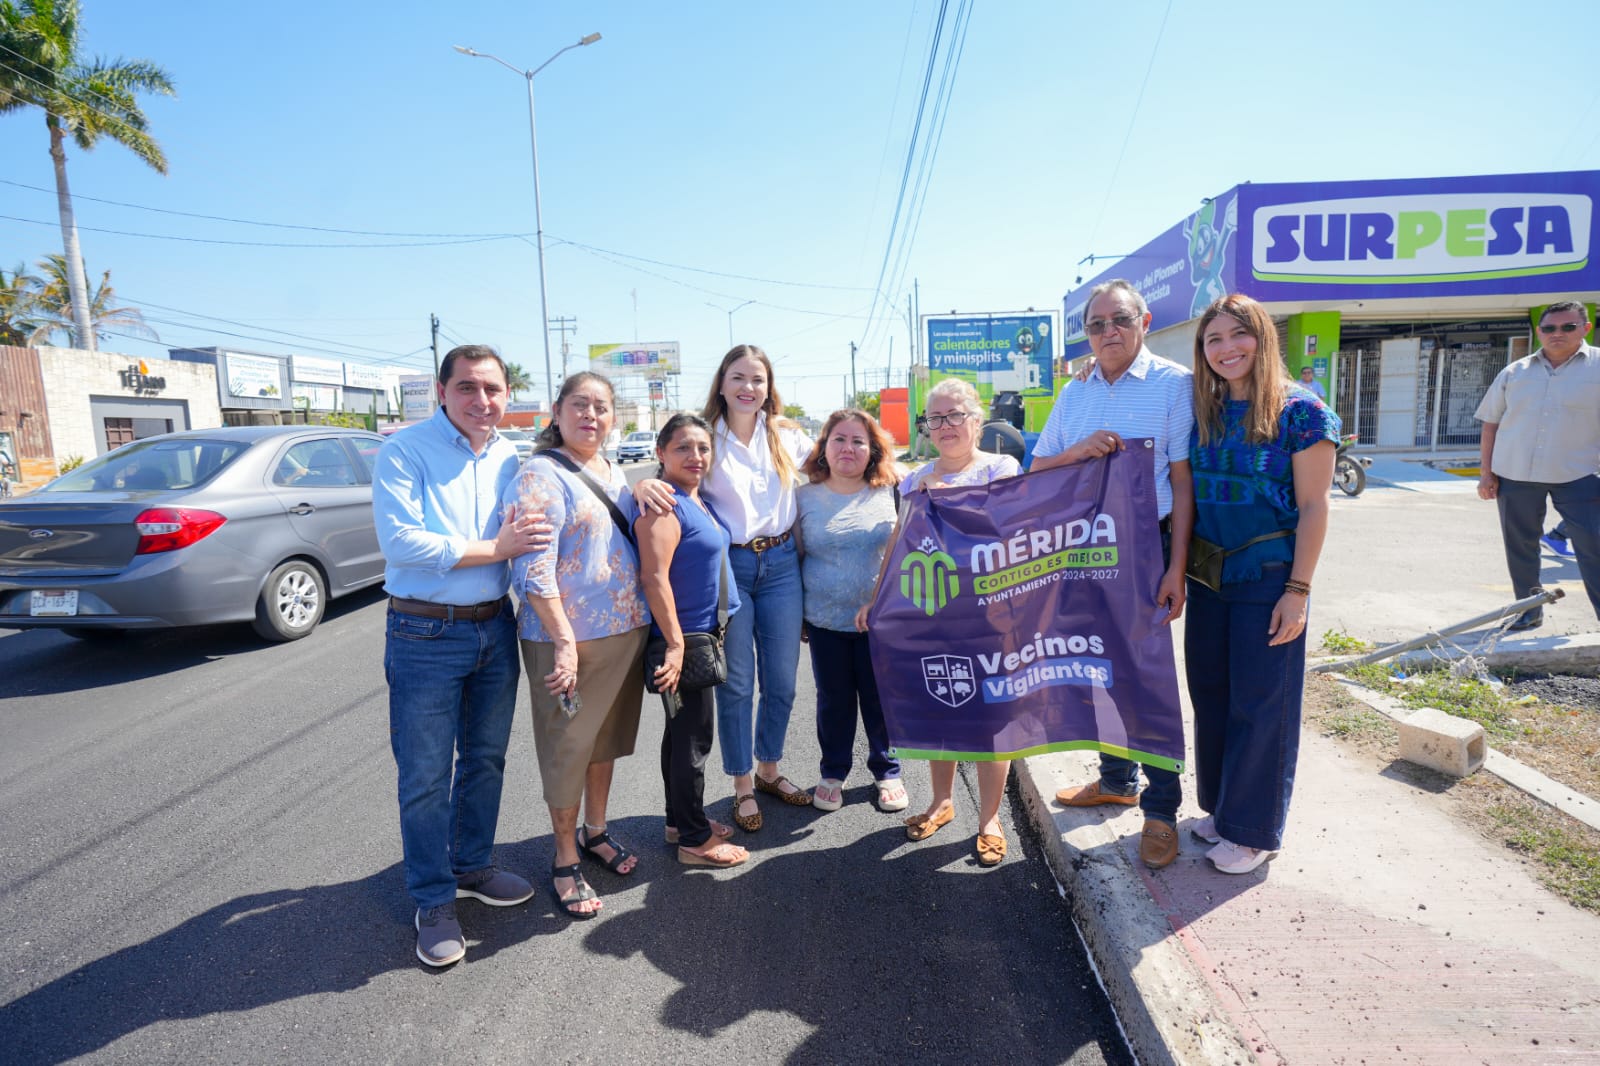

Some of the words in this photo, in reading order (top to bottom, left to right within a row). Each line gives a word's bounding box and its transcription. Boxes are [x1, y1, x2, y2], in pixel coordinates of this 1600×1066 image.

[1266, 205, 1574, 263] SURPESA
[1154, 259, 1184, 284] Plomero
[934, 337, 1010, 351] calentadores
[934, 354, 942, 367] y
[944, 351, 1002, 366] minisplits
[971, 513, 1117, 573] MÉRIDA
[977, 573, 1060, 606] AYUNTAMIENTO
[1062, 569, 1119, 580] 2024-2027
[978, 563, 1042, 590] CONTIGO
[1047, 556, 1062, 569] ES
[1067, 551, 1113, 565] MEJOR
[977, 632, 1104, 674] Vecinos
[985, 661, 1109, 697] Vigilantes
